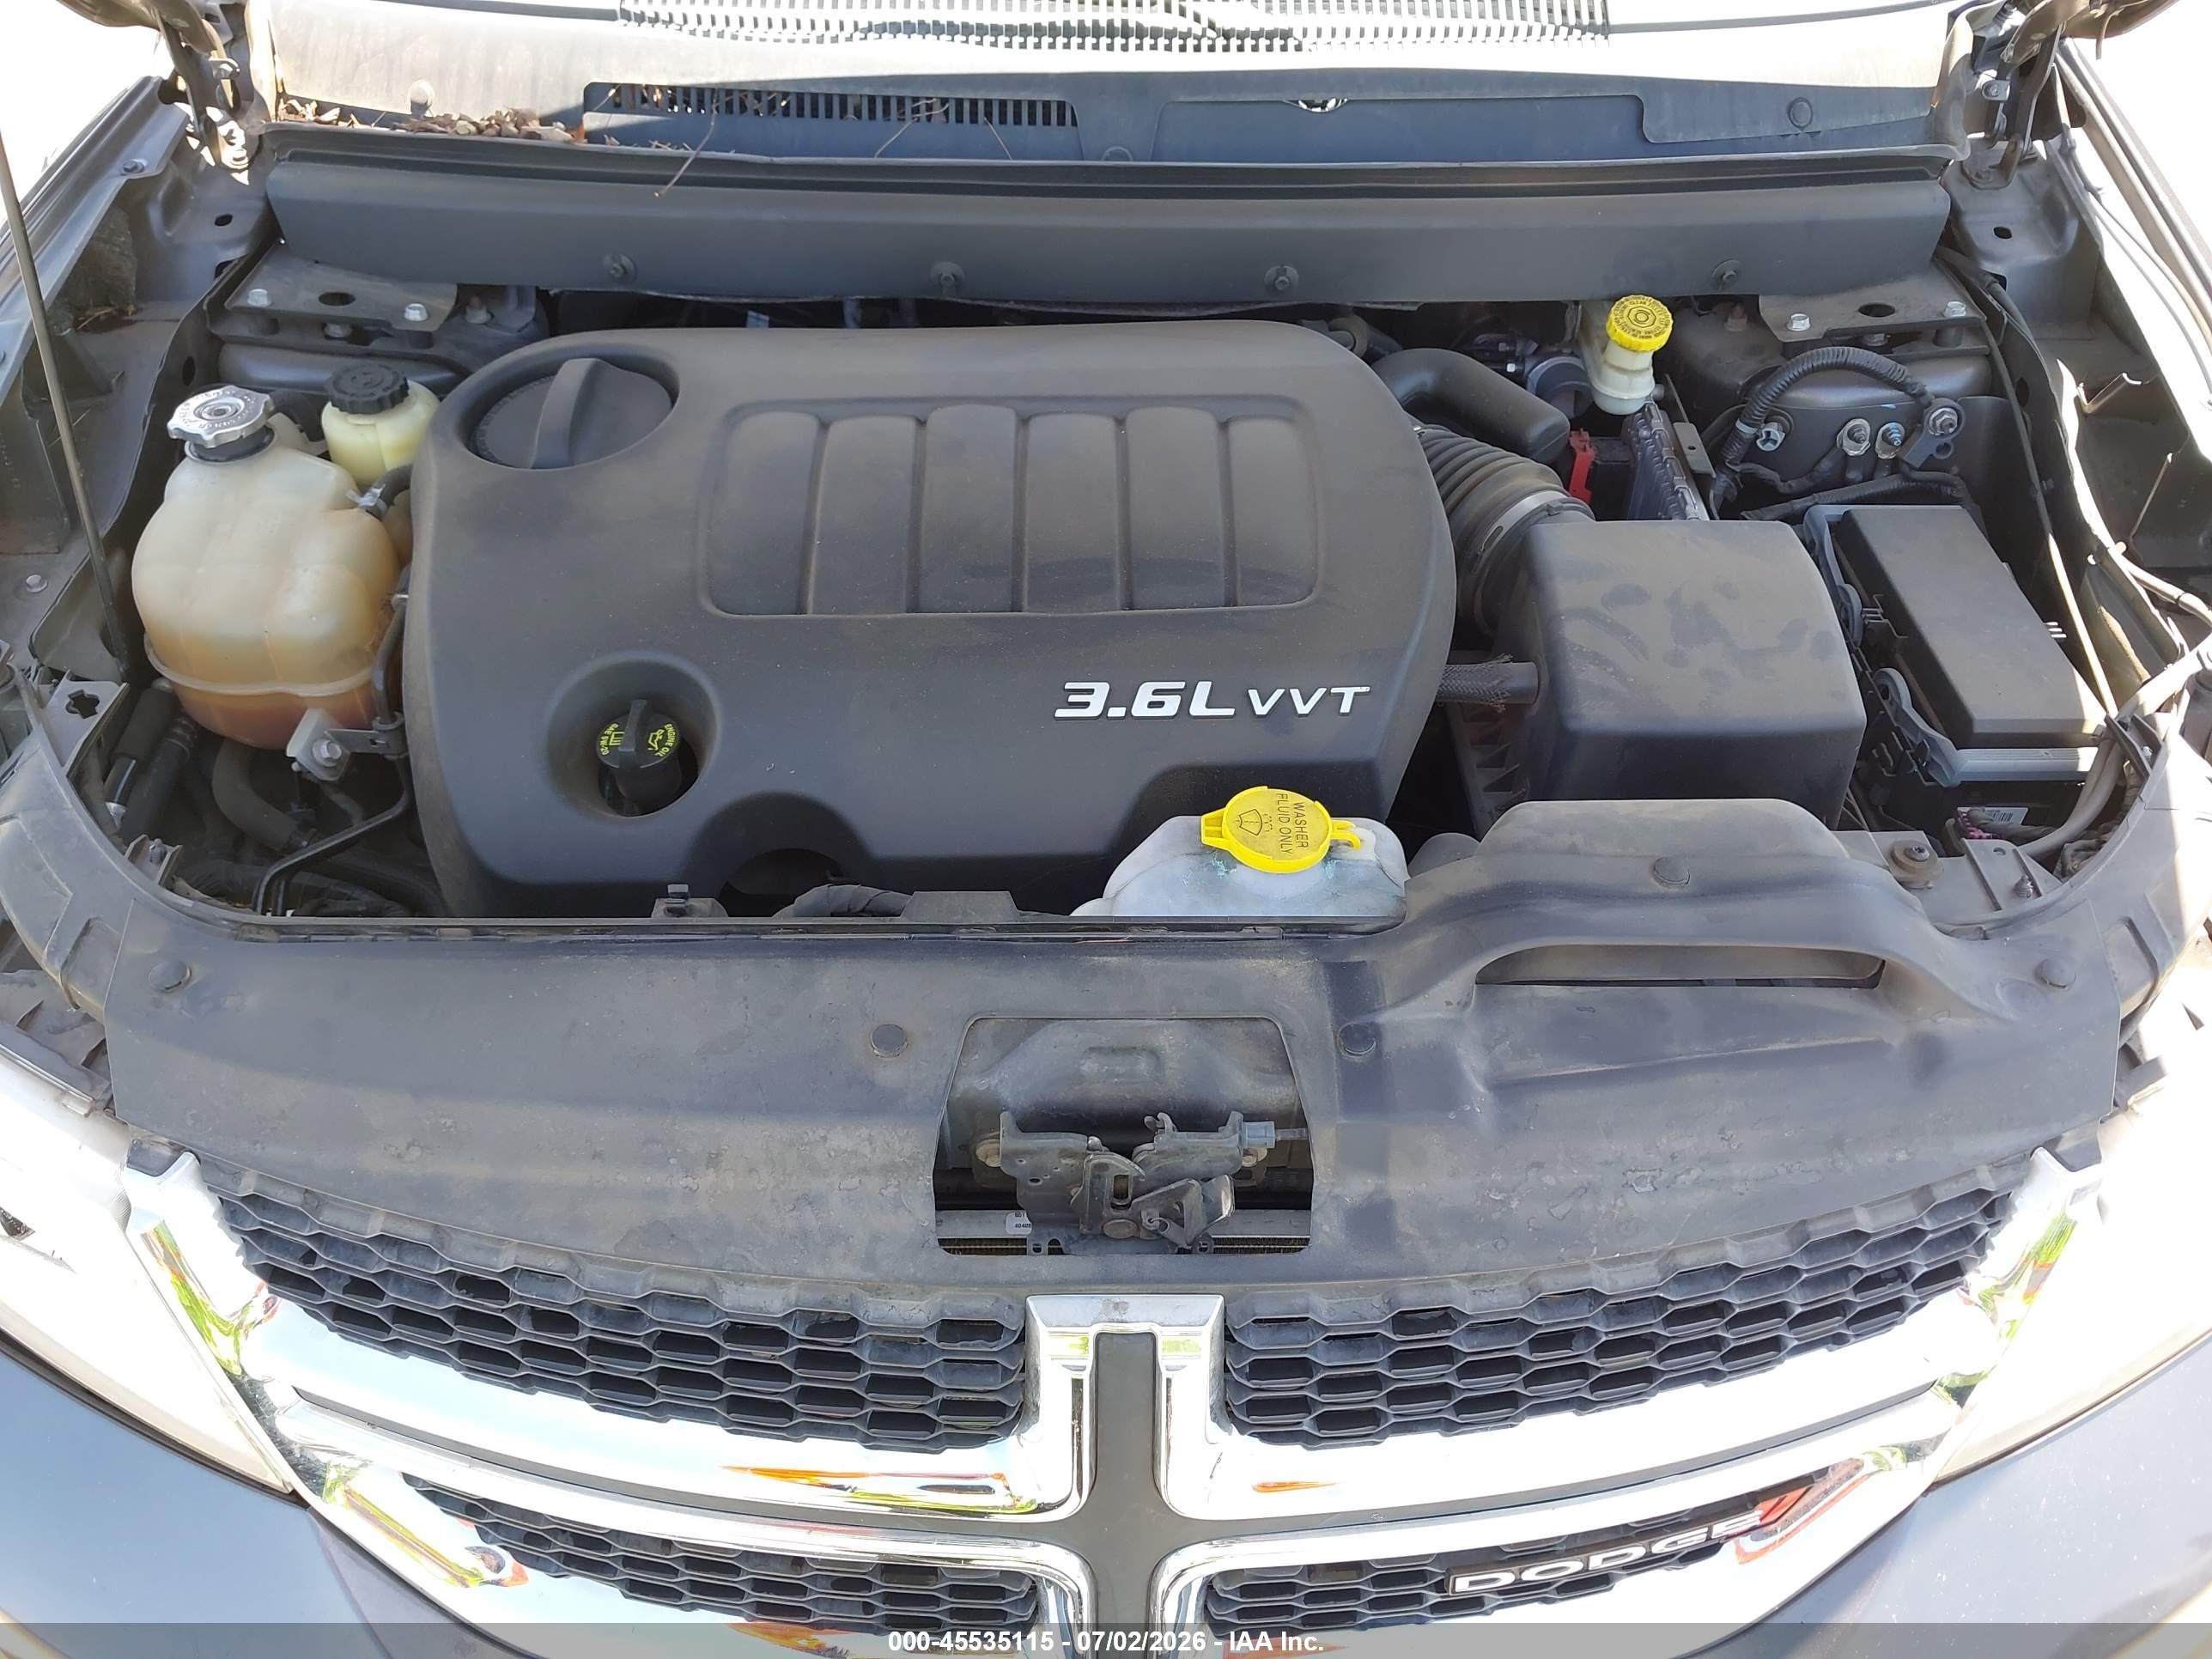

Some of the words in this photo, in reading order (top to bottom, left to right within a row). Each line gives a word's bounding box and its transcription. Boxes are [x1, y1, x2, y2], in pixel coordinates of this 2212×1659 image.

[1054, 681, 1236, 718] 3.6L
[1247, 686, 1370, 716] VVT
[664, 723, 676, 747] ENGINE
[654, 746, 670, 757] OIL
[1276, 793, 1290, 823] FLUID
[1278, 825, 1292, 854] ONLY
[1293, 801, 1309, 848] WASHER
[1455, 1510, 1764, 1593] DODGE
